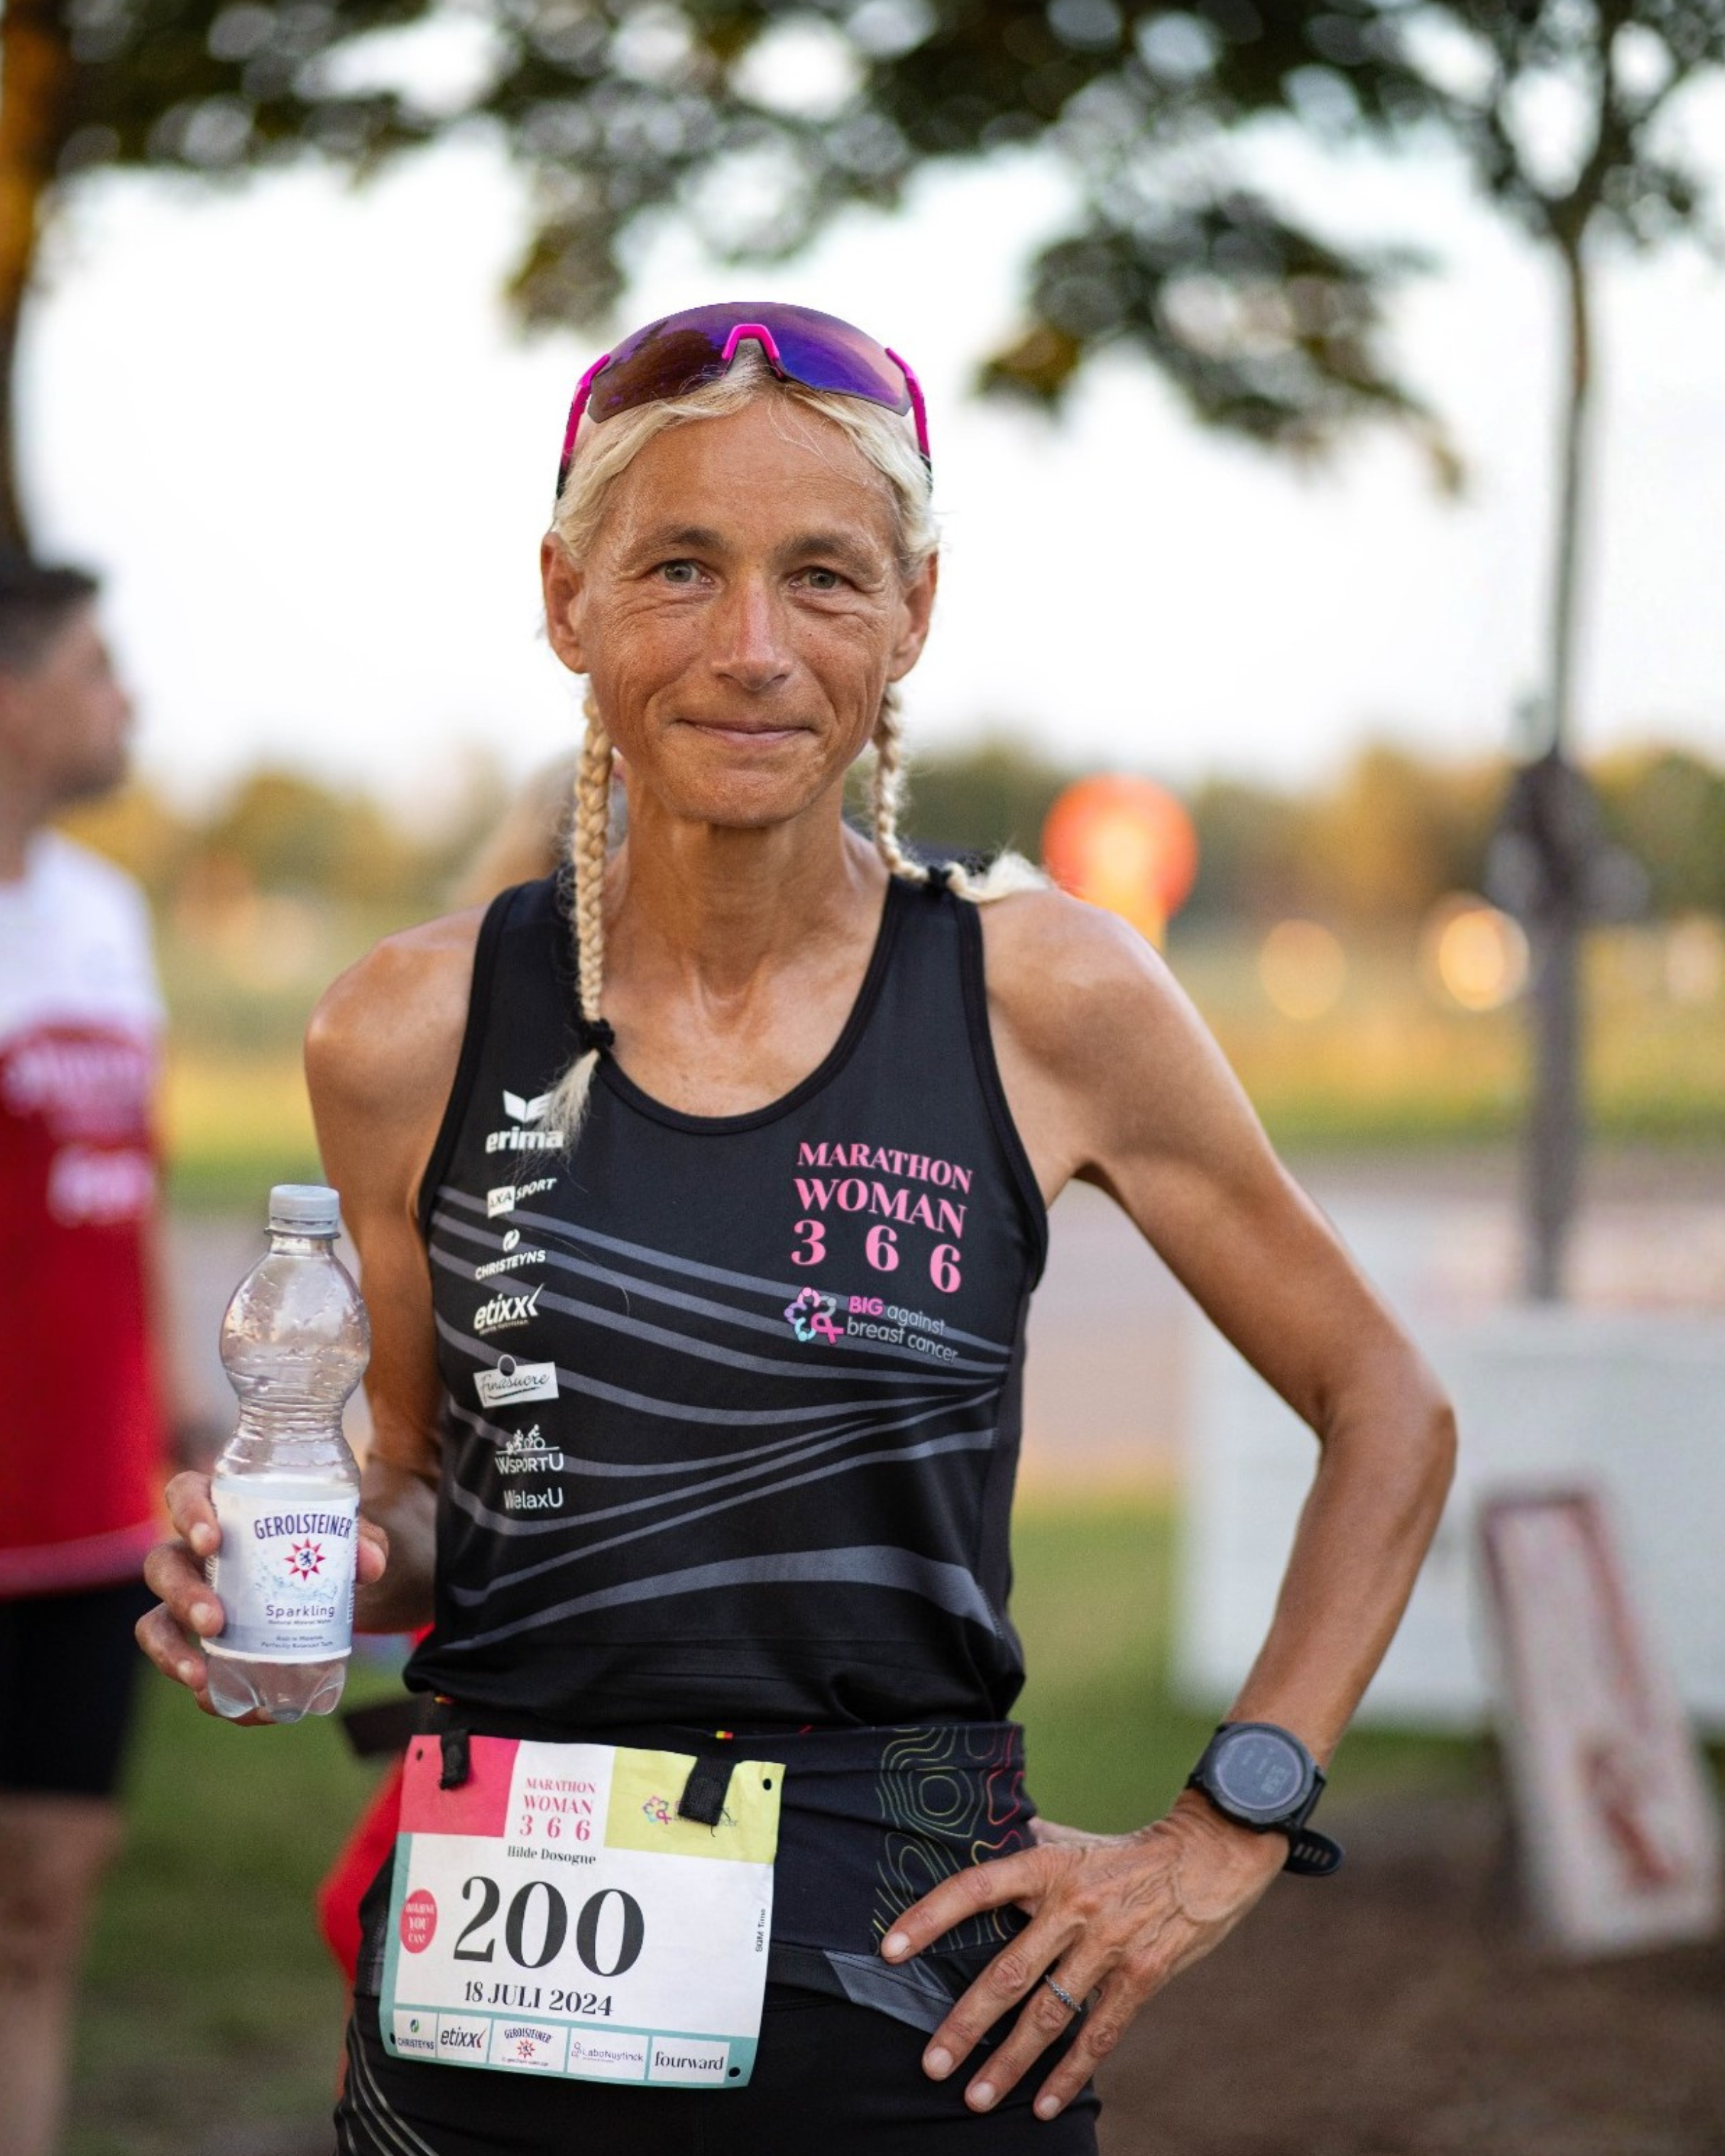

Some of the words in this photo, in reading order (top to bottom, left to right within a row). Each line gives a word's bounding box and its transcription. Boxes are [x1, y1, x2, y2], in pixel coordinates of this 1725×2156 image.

[486, 1126, 564, 1154] erima
[796, 1142, 973, 1194] MARATHON
[515, 1177, 558, 1201] SPORT
[793, 1178, 968, 1239] WOMAN
[475, 1250, 546, 1280] CHRISTEYNS
[848, 1295, 885, 1316] BIG
[887, 1304, 945, 1336] against
[847, 1316, 904, 1344] breast
[907, 1333, 958, 1363] cancer
[503, 1487, 564, 1509] WelaxU
[254, 1513, 353, 1539] GEROLSTEINER
[266, 1605, 335, 1619] Sparkling
[526, 1778, 596, 1793] MARATHON
[524, 1794, 593, 1815] WOMAN
[507, 1845, 537, 1858] Hilde
[541, 1848, 596, 1865] Dosogne
[453, 1876, 645, 1977] 200
[465, 1981, 483, 2002] 18
[488, 1984, 541, 2008] JULI
[549, 1989, 613, 2016] 2024
[398, 2037, 434, 2050] CHRISTEYNS
[440, 2026, 481, 2048] etixx
[655, 2051, 724, 2071] fourward
